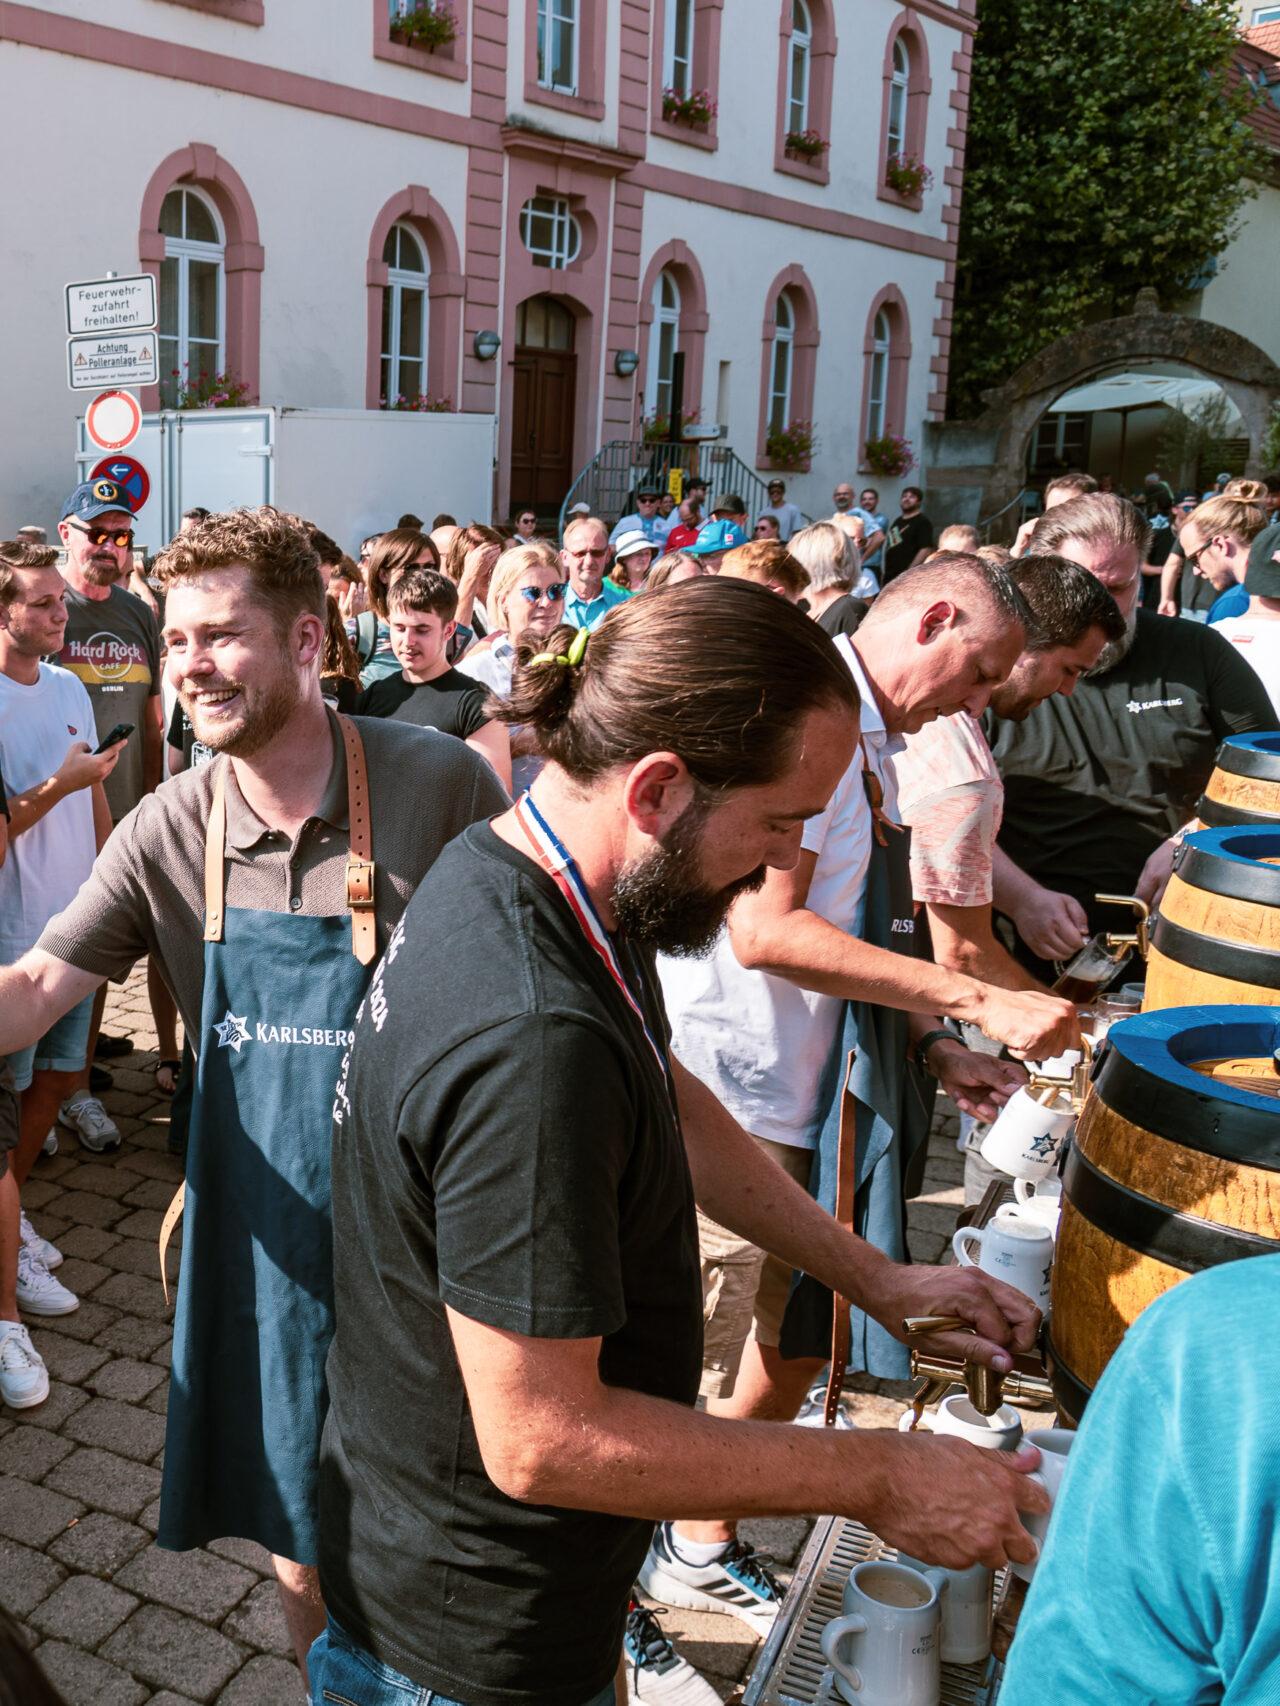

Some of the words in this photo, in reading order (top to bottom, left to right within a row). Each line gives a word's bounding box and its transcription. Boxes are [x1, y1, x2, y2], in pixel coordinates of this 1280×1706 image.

[78, 285, 142, 300] Feuerwehr-
[92, 299, 130, 312] zufahrt
[84, 311, 139, 326] freihalten!
[97, 343, 129, 353] Achtung
[88, 355, 137, 368] Polleranlage
[69, 640, 106, 658] Hard
[108, 641, 142, 661] Rock
[99, 662, 121, 670] CAFE
